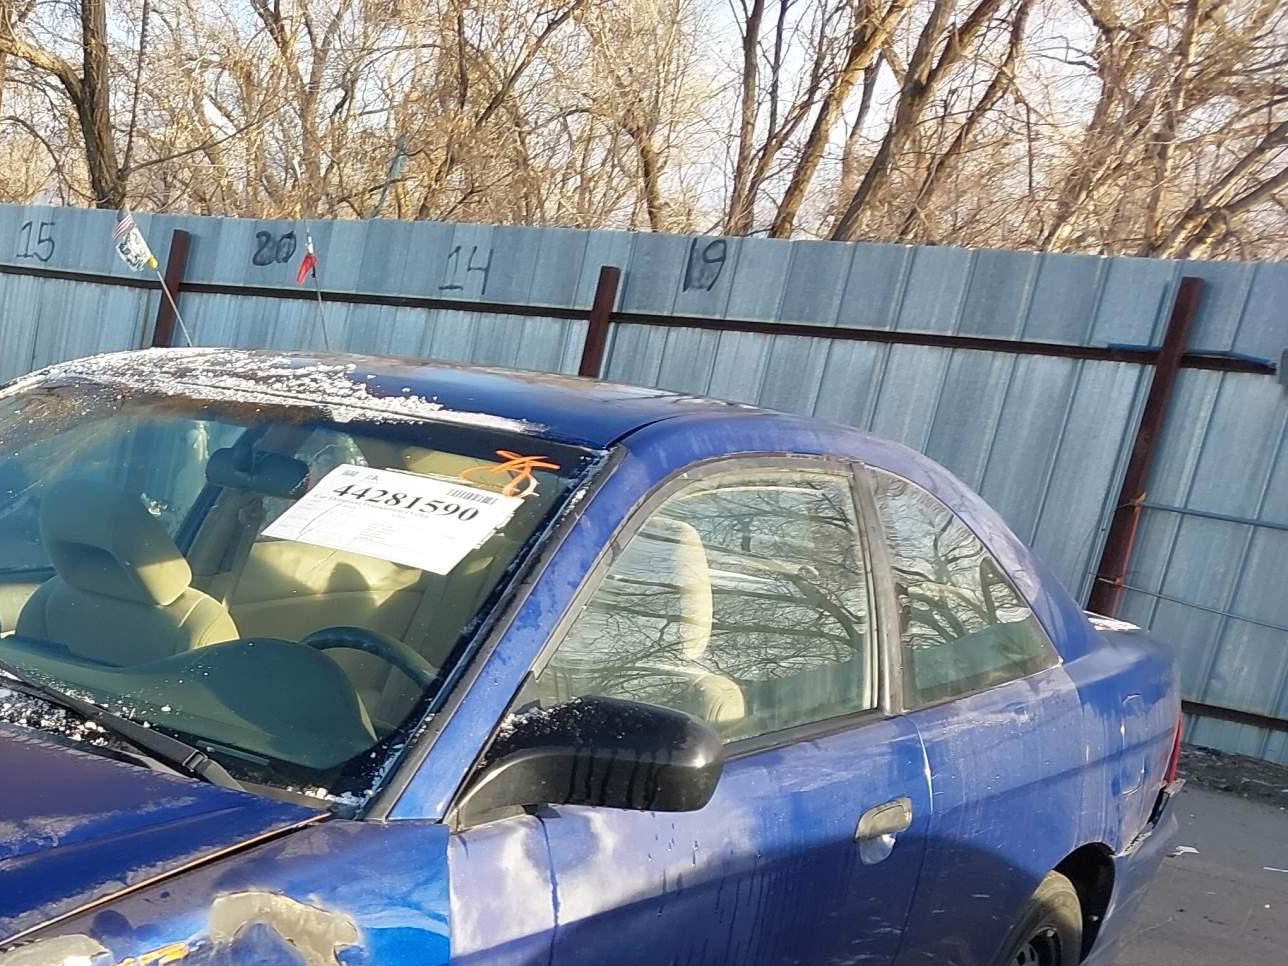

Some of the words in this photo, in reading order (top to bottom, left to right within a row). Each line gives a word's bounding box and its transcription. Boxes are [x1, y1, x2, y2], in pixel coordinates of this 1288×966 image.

[16, 221, 57, 262] 15
[253, 230, 297, 267] 20
[438, 245, 494, 295] 14
[682, 237, 727, 292] 19
[332, 483, 480, 522] 44281590
